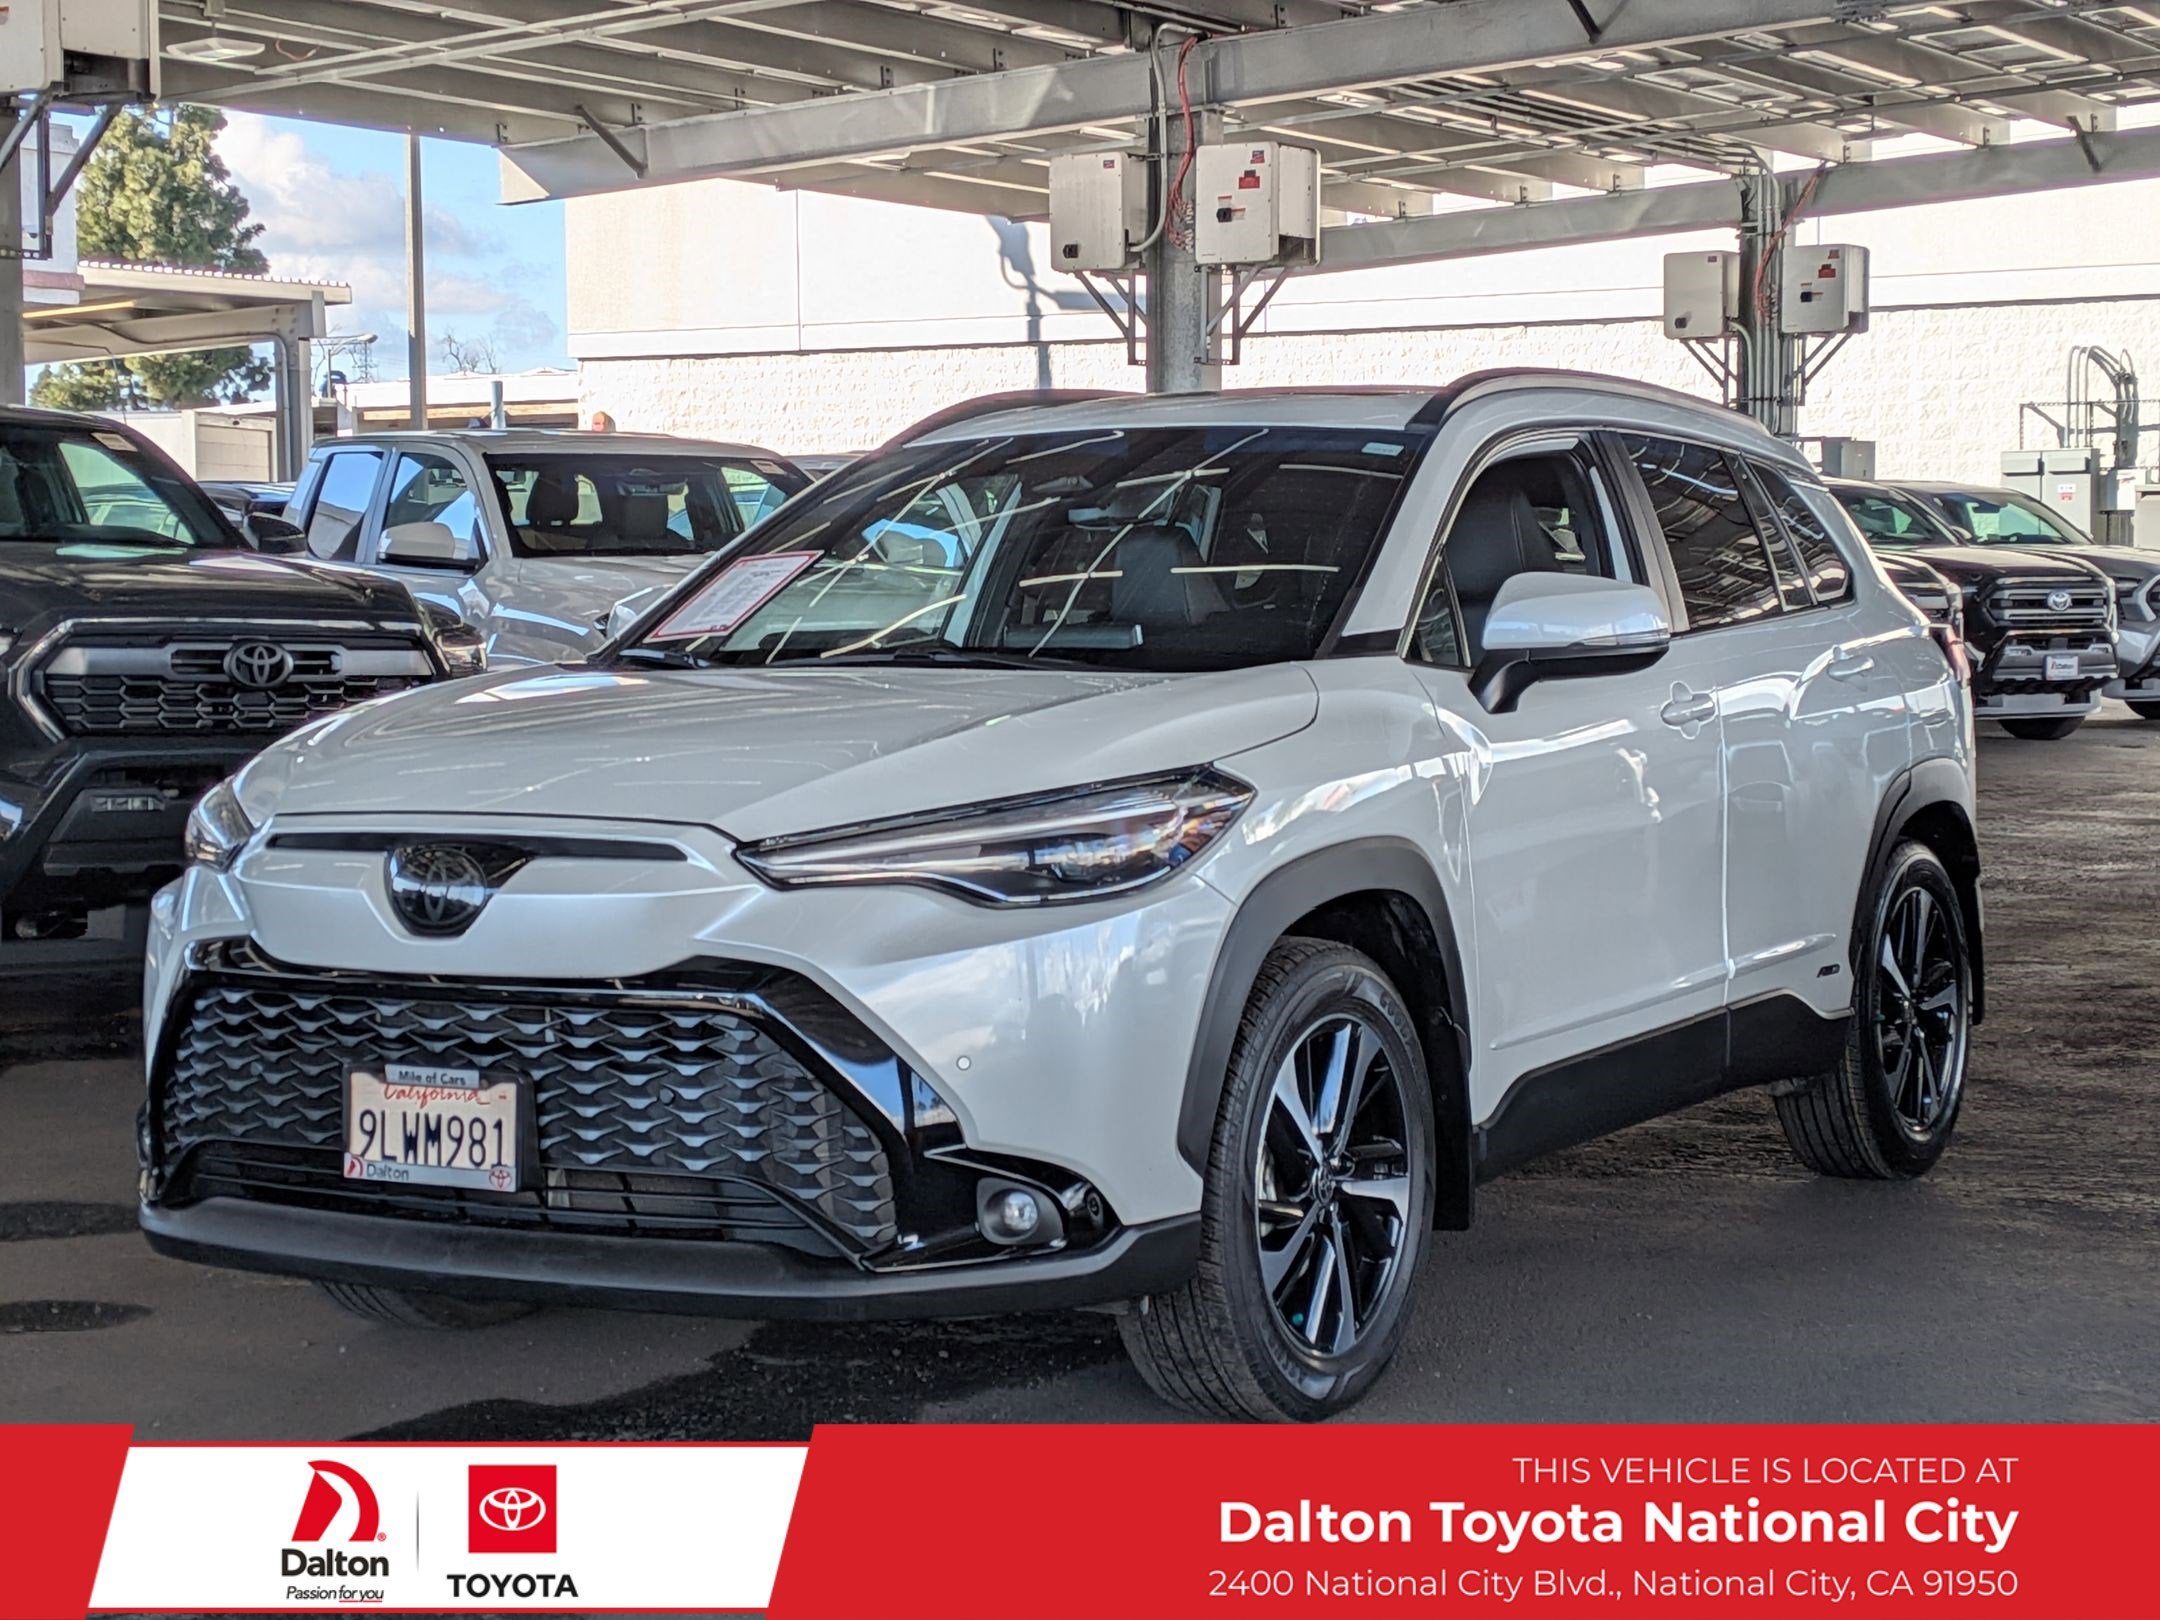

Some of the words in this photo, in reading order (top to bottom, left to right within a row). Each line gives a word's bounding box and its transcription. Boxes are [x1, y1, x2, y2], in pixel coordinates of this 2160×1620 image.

[398, 1070, 422, 1081] Mile
[425, 1071, 437, 1084] of
[440, 1072, 467, 1086] Cars
[359, 1108, 509, 1168] 9LWM981
[365, 1163, 410, 1181] Dalton
